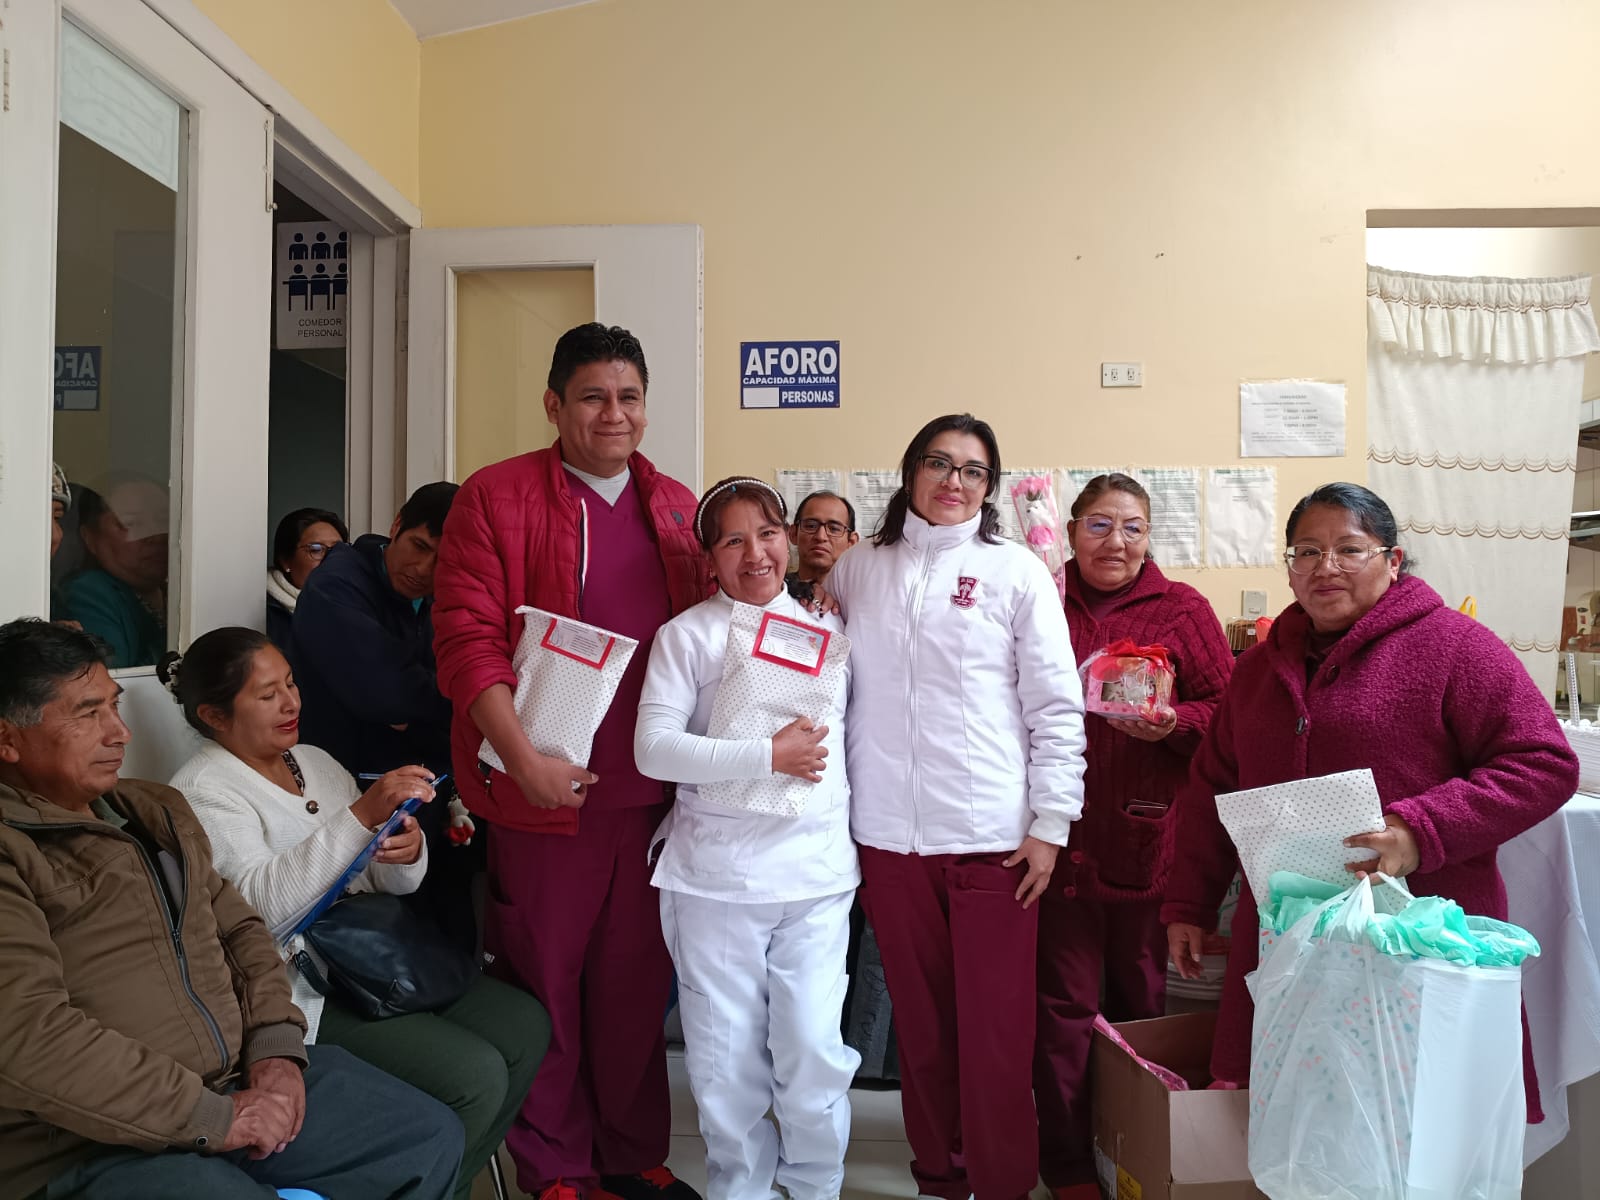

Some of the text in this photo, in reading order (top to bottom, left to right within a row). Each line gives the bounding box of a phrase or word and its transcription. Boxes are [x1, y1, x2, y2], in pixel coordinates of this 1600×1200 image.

[298, 319, 342, 327] COMEDOR
[297, 329, 343, 337] PERSONAL
[745, 347, 838, 375] AFORO
[743, 376, 837, 385] CAPACIDAD MÁXIMA
[781, 391, 835, 403] PERSONAS
